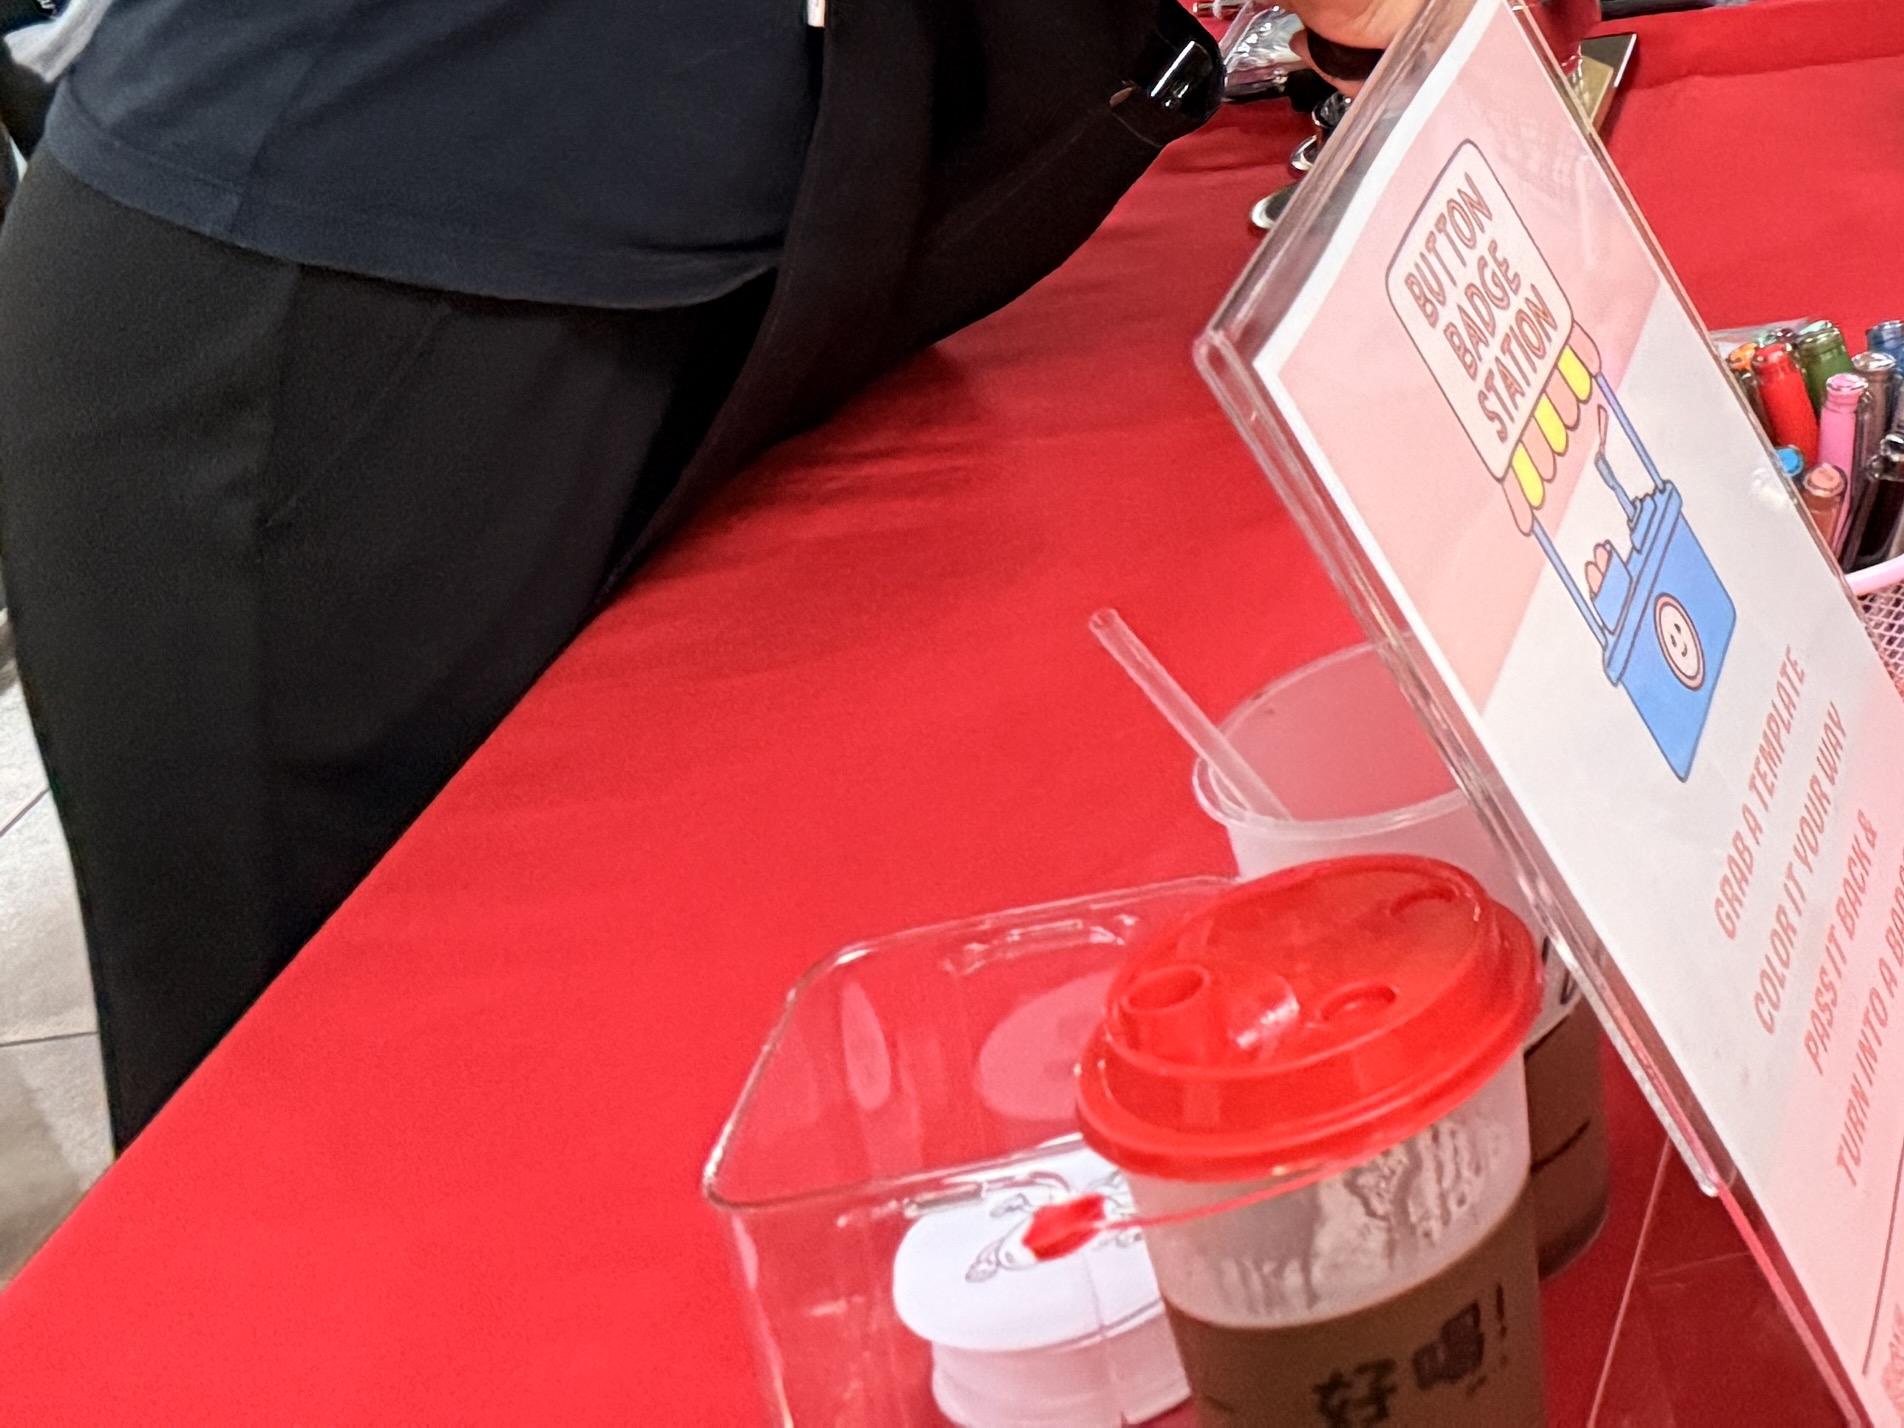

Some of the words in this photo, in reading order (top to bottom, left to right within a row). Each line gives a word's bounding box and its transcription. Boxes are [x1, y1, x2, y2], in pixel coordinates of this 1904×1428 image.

[1404, 172, 1493, 329] BUTTON
[1444, 239, 1521, 381] BADGE
[1478, 283, 1558, 443] STATION
[1748, 644, 1805, 813] TEMPLATE
[1816, 700, 1847, 786] WAY
[1741, 803, 1763, 846] A
[1793, 774, 1831, 874] YOUR
[1857, 808, 1878, 850] &
[1714, 830, 1754, 941] GRAB
[1783, 861, 1807, 918] IT
[1835, 833, 1872, 941] BACK
[1754, 903, 1798, 1035] COLOR
[1825, 923, 1848, 980] IT
[1803, 964, 1838, 1076] PASS
[1836, 1072, 1870, 1187] TURN
[1856, 986, 1889, 1087] INTO
[1878, 957, 1898, 999] A
